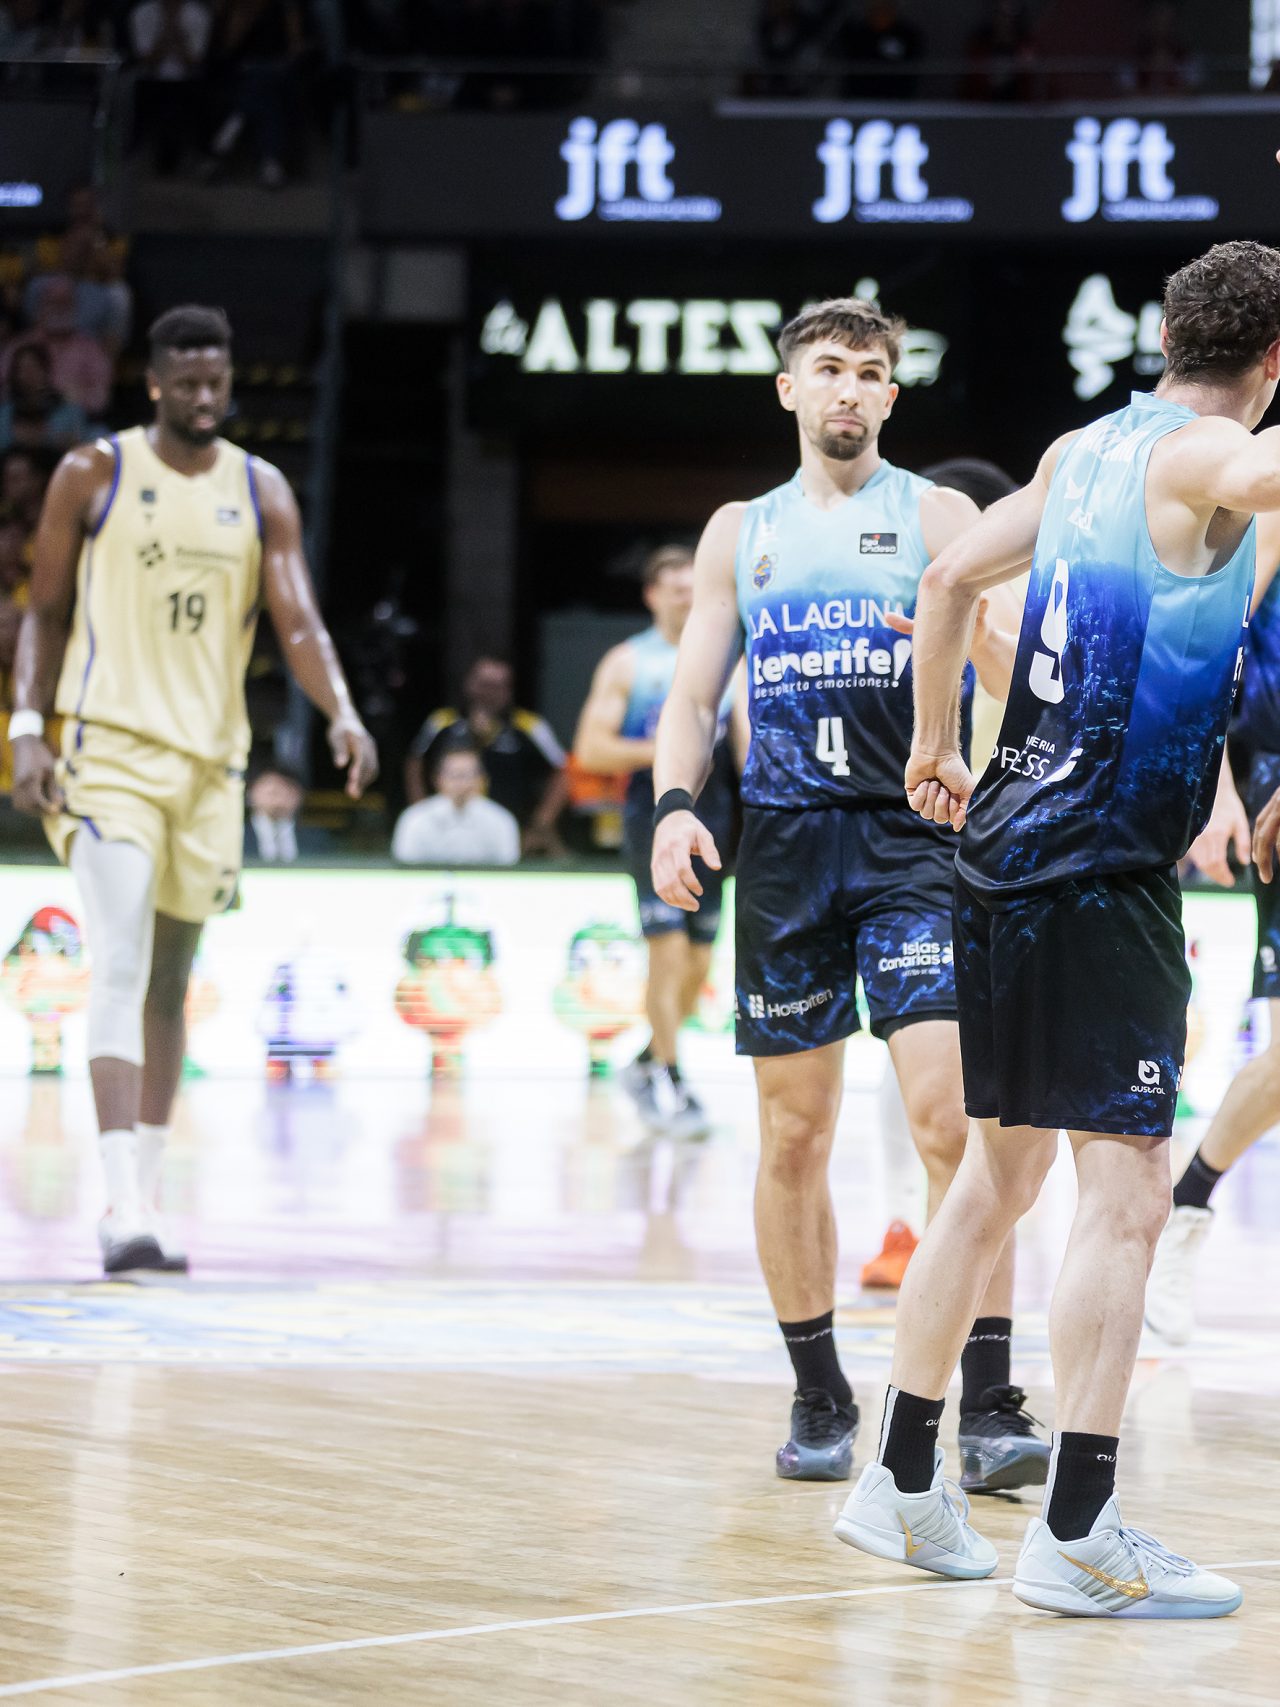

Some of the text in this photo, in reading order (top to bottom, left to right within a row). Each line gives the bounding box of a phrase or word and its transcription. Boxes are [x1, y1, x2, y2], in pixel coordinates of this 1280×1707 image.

[555, 116, 675, 221] jft
[812, 118, 928, 223] jft
[1061, 117, 1176, 222] jft
[521, 298, 786, 374] ALTEZ
[168, 591, 206, 634] 19
[1028, 558, 1069, 705] 9
[753, 637, 913, 689] tenerife!
[815, 675, 890, 691] emociones
[815, 716, 851, 777] 4
[878, 954, 941, 972] Canarias
[902, 941, 941, 956] Islas
[767, 988, 834, 1019] Hospiten
[1130, 1085, 1166, 1095] austral
